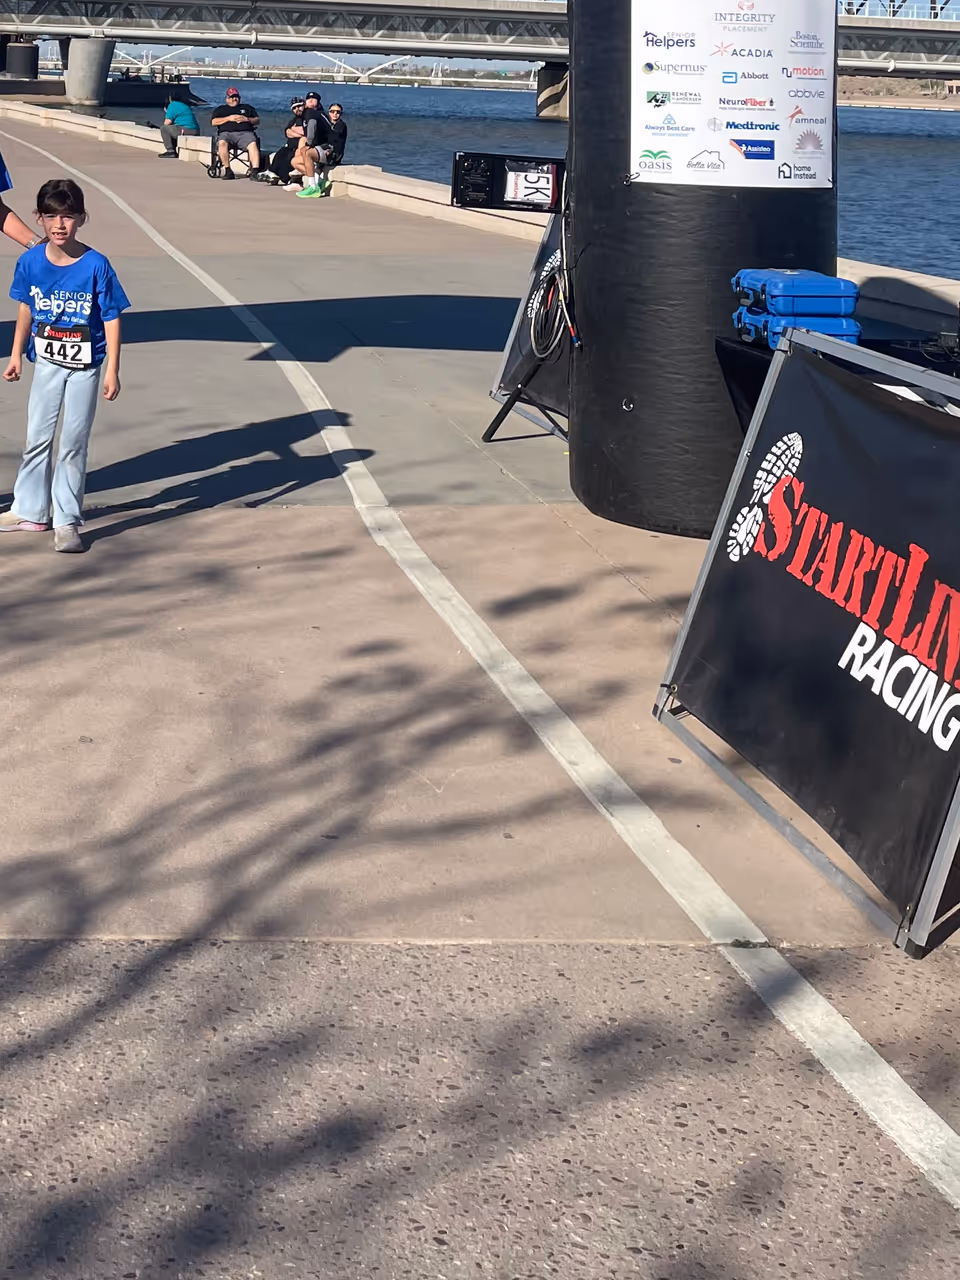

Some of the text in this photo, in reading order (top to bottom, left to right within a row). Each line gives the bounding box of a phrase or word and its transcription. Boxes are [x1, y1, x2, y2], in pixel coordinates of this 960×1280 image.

[714, 13, 776, 22] INTEGRITY
[646, 36, 696, 49] Helpers
[731, 49, 773, 58] ACADIA
[654, 61, 705, 74] Supernus
[740, 71, 769, 80] Abbott
[788, 89, 825, 98] abbvie
[726, 121, 780, 130] Medtronic
[639, 160, 672, 169] oasis
[686, 160, 704, 168] Bella
[793, 163, 811, 171] home
[524, 174, 551, 198] 5K
[53, 290, 93, 302] SENIOR
[44, 341, 83, 362] 442
[753, 475, 960, 689] STARTLIN
[837, 622, 960, 751] RACING
